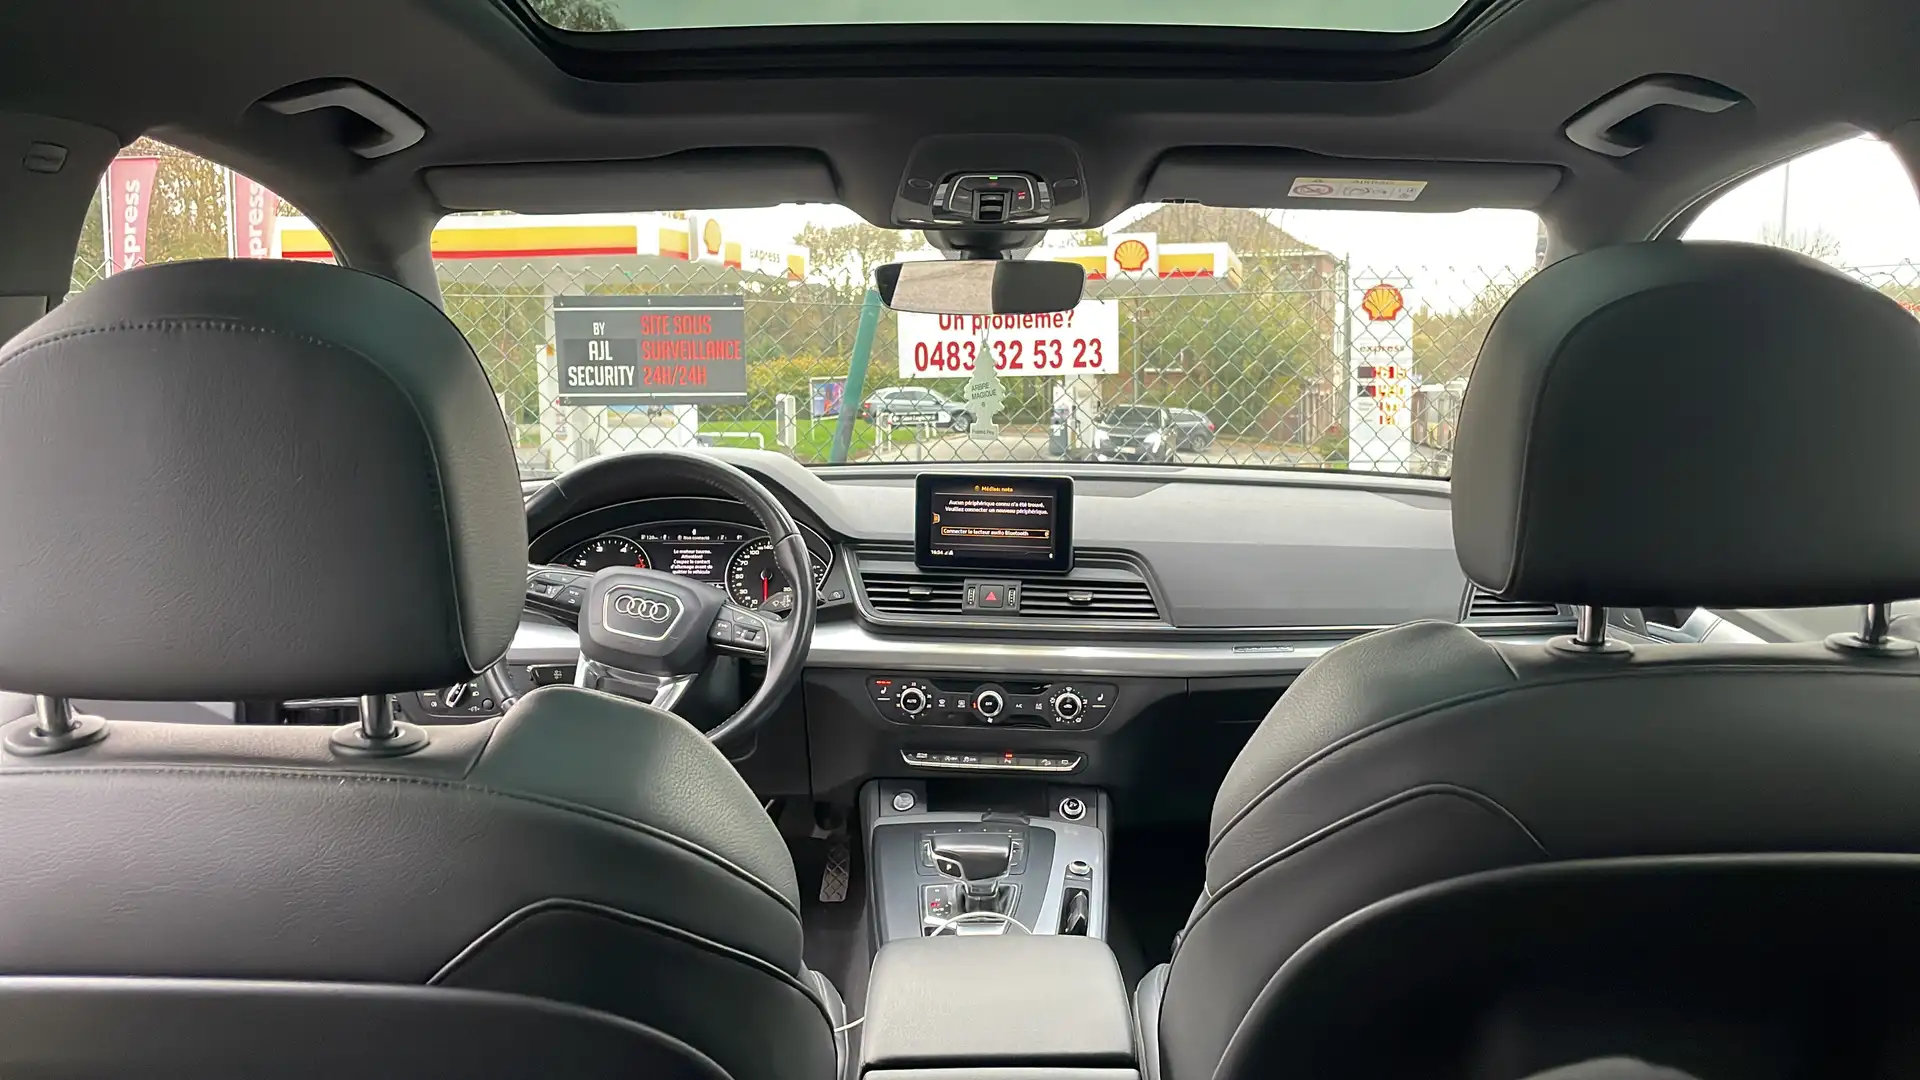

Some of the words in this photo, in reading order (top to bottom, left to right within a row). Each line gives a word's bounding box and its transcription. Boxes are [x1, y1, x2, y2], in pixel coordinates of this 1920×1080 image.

[123, 178, 141, 270] xpress
[249, 183, 268, 258] press
[593, 322, 605, 336] BY
[640, 315, 670, 335] SITE
[673, 314, 712, 335] SOUS
[939, 313, 964, 331] Un
[588, 340, 613, 361] AJL
[641, 340, 742, 361] SURVEILLANCE
[914, 341, 976, 371] 0483
[993, 340, 1023, 370] 32
[1033, 339, 1063, 369] 53
[1073, 338, 1102, 368] 23
[568, 365, 635, 387] SECURITY
[643, 364, 707, 386] 24H/24H
